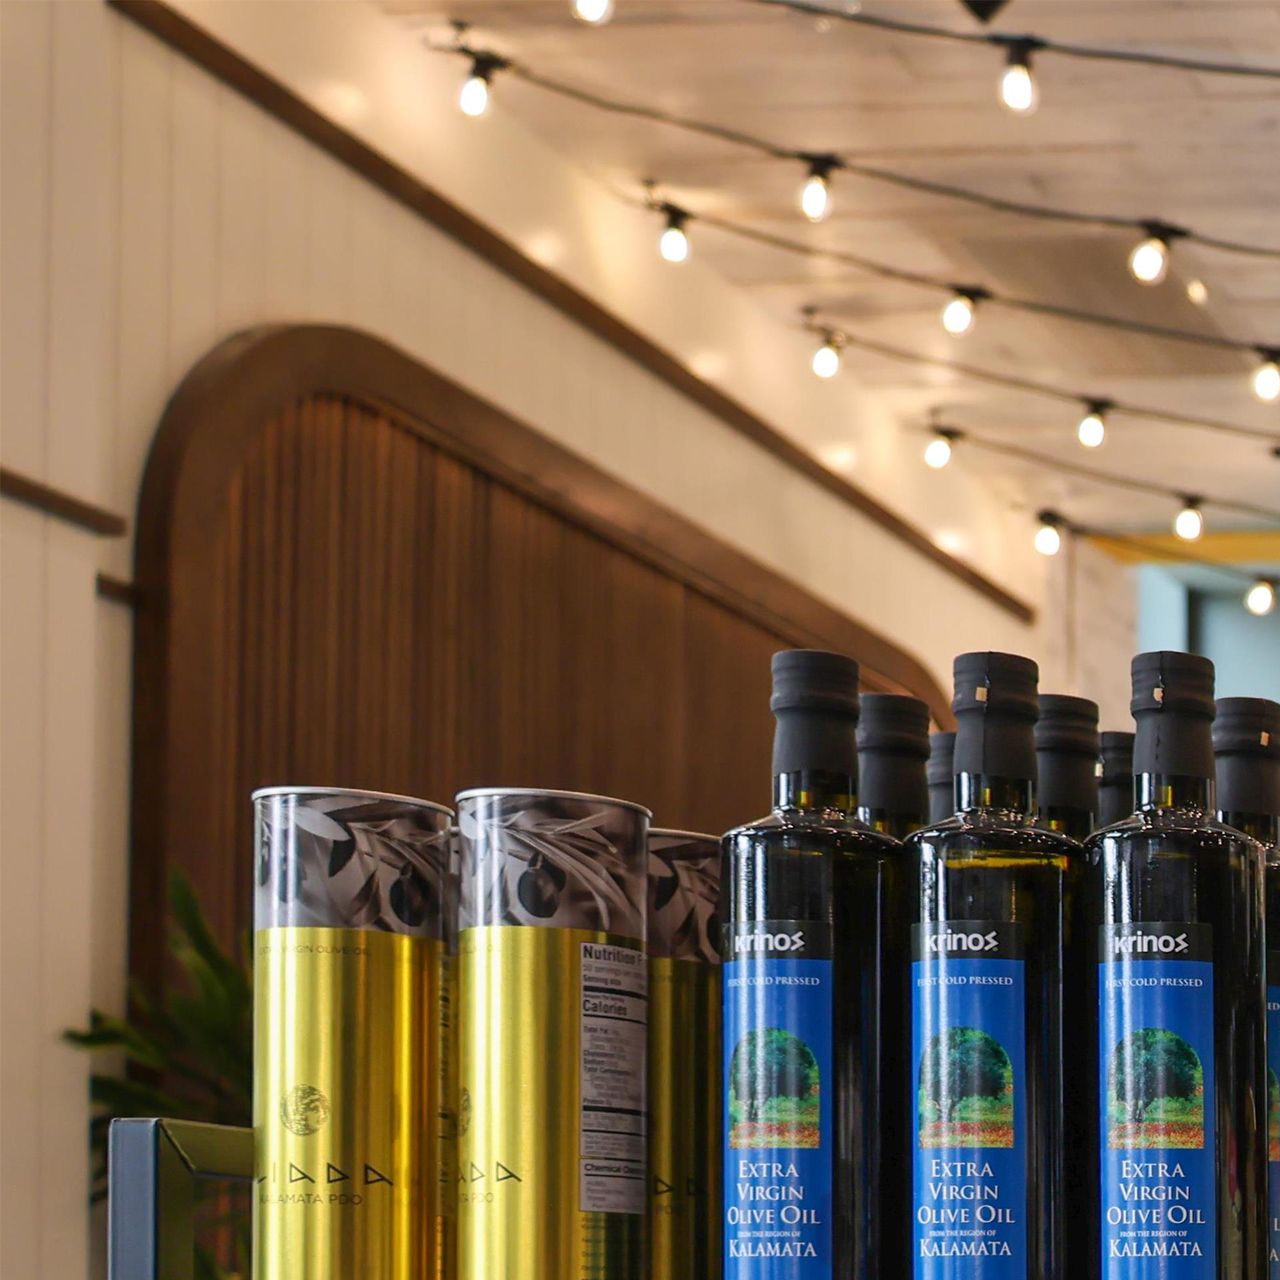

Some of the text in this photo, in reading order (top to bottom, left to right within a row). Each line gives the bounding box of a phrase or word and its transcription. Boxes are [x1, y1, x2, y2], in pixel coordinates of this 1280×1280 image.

[926, 930, 998, 952] Krinos
[932, 1160, 993, 1178] EXTRA
[929, 1184, 998, 1201] VIRGIN
[918, 1205, 1014, 1225] OLIVE OIL
[920, 1240, 1011, 1257] KALAMATA
